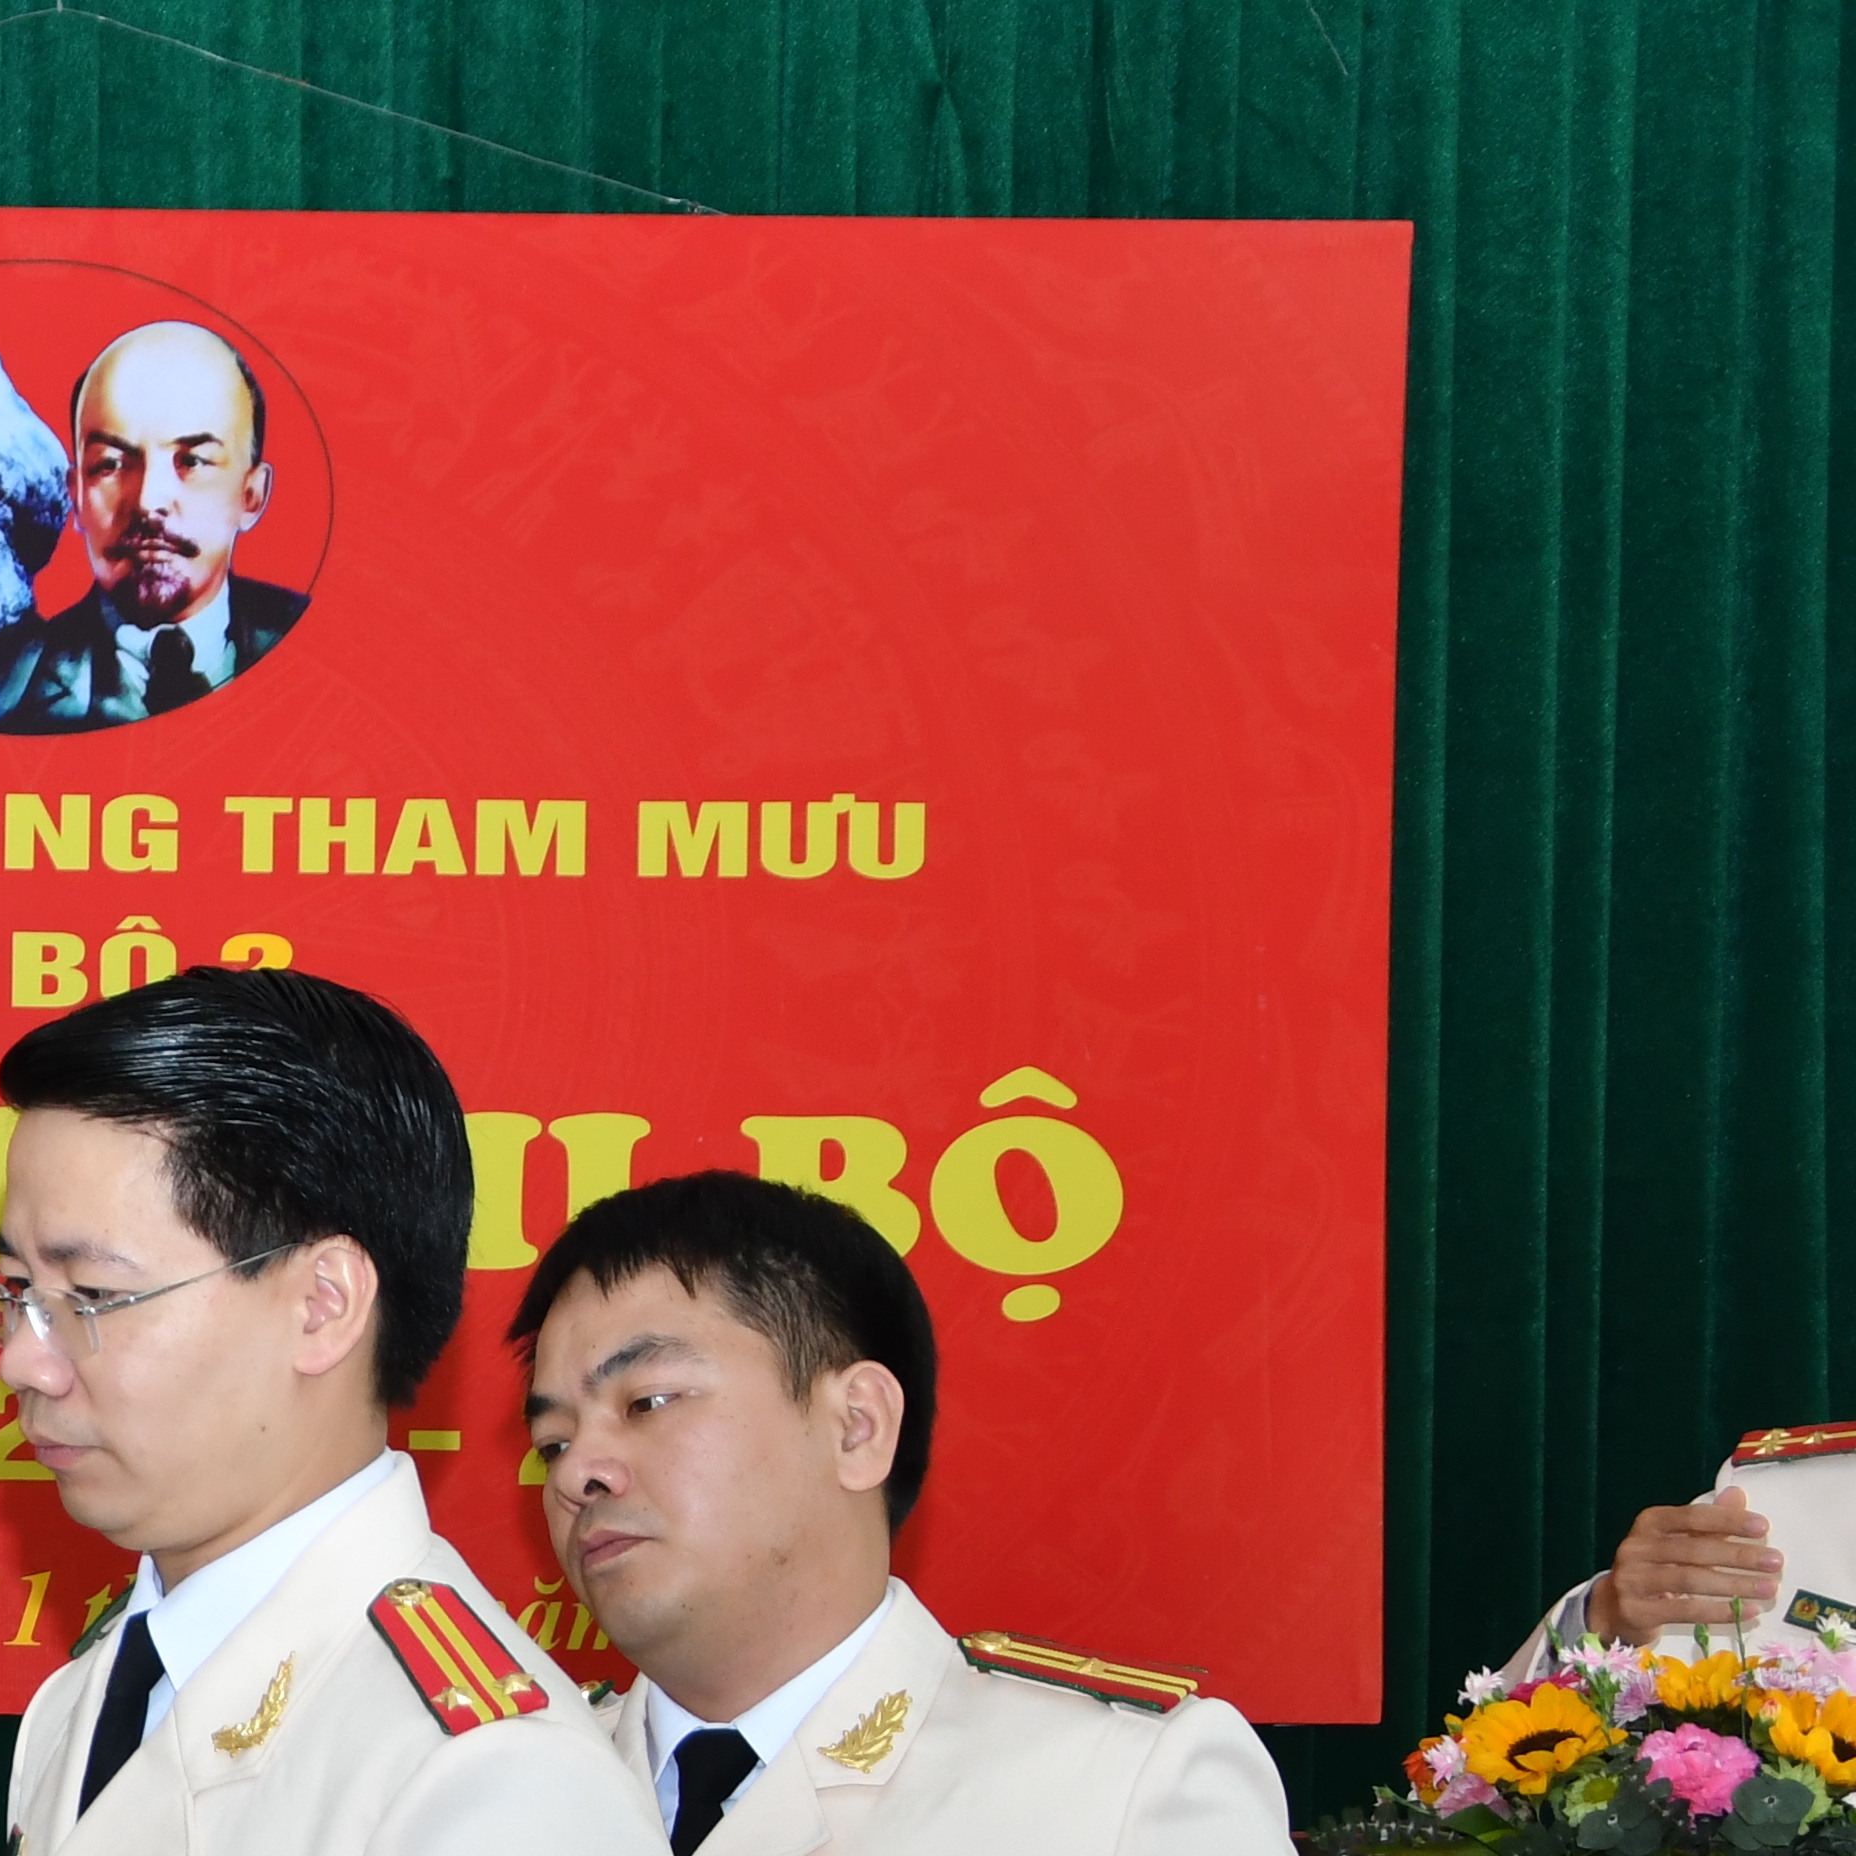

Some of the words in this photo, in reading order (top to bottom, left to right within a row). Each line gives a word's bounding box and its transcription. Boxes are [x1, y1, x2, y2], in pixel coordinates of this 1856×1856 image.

[224, 796, 587, 877] THAM
[637, 793, 927, 880] MƯU
[740, 1065, 1124, 1322] BỘ
